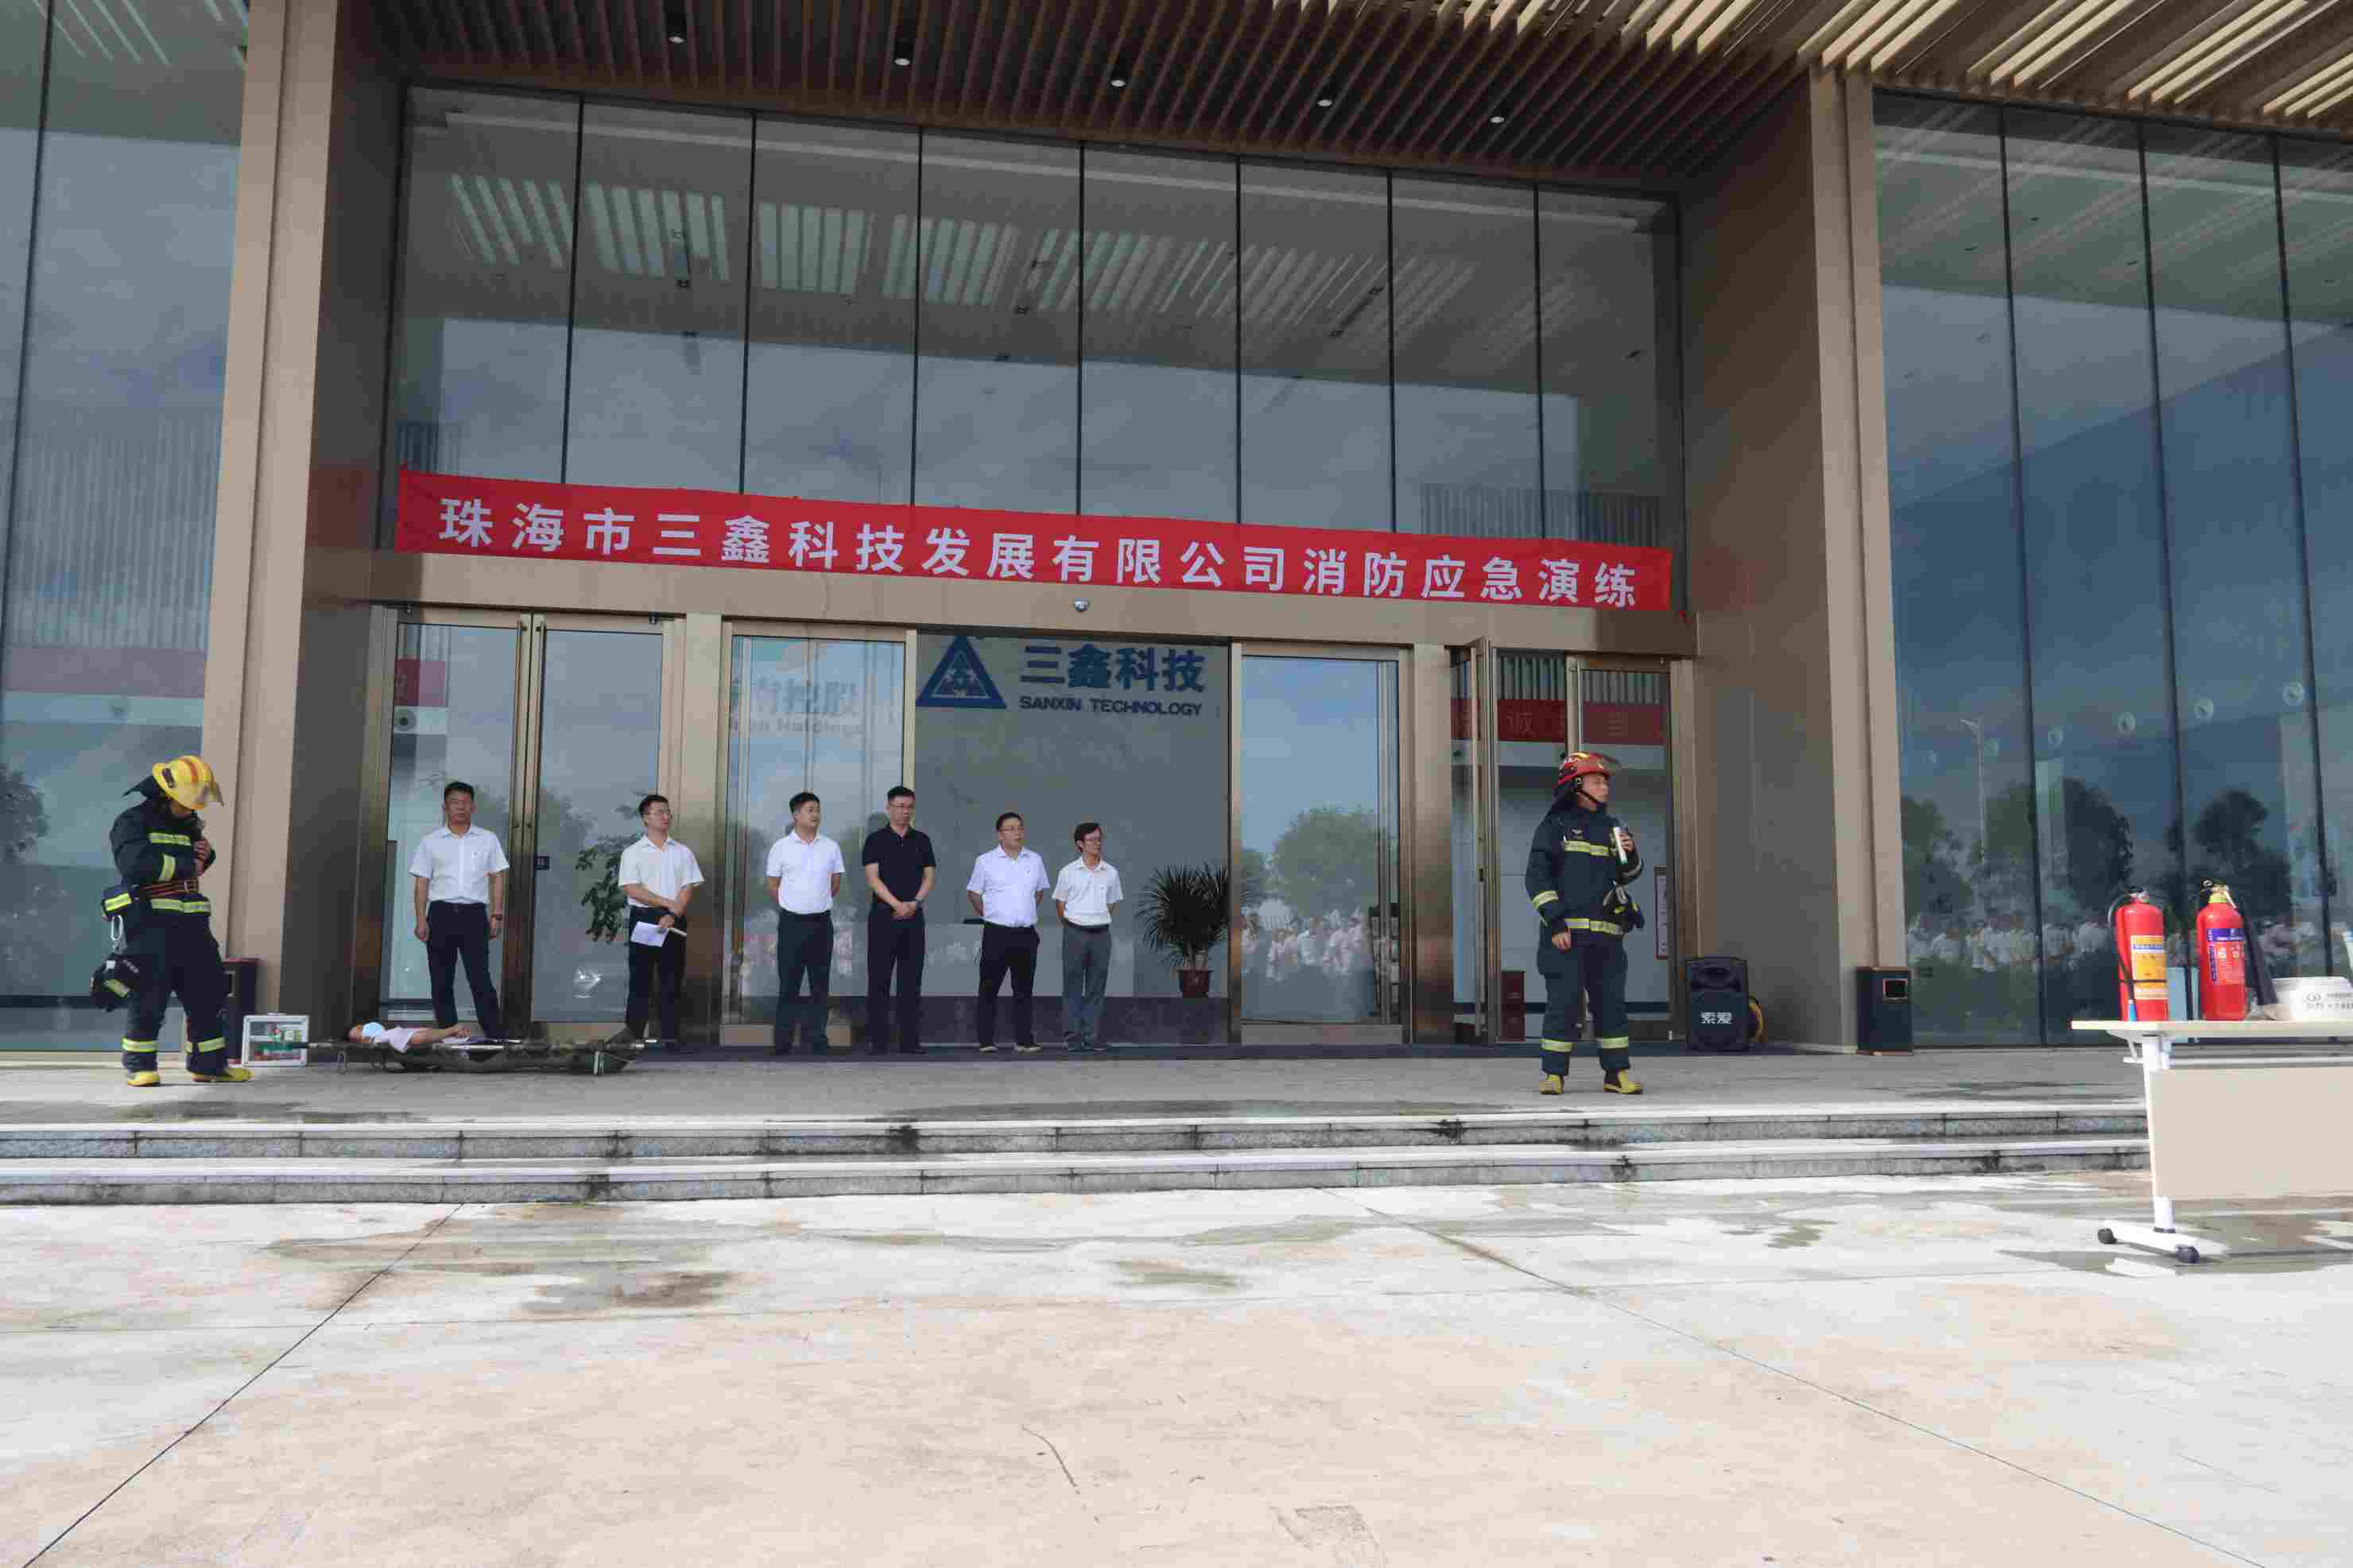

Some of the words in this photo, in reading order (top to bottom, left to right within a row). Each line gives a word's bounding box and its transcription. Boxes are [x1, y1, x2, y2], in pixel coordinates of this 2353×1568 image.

[437, 497, 1638, 610] 珠海市三鑫科技发展有限公司消防应急演练
[1019, 644, 1207, 693] 三鑫科技
[1019, 695, 1082, 711] SANXIN
[1090, 699, 1203, 716] TECHNOLOGY
